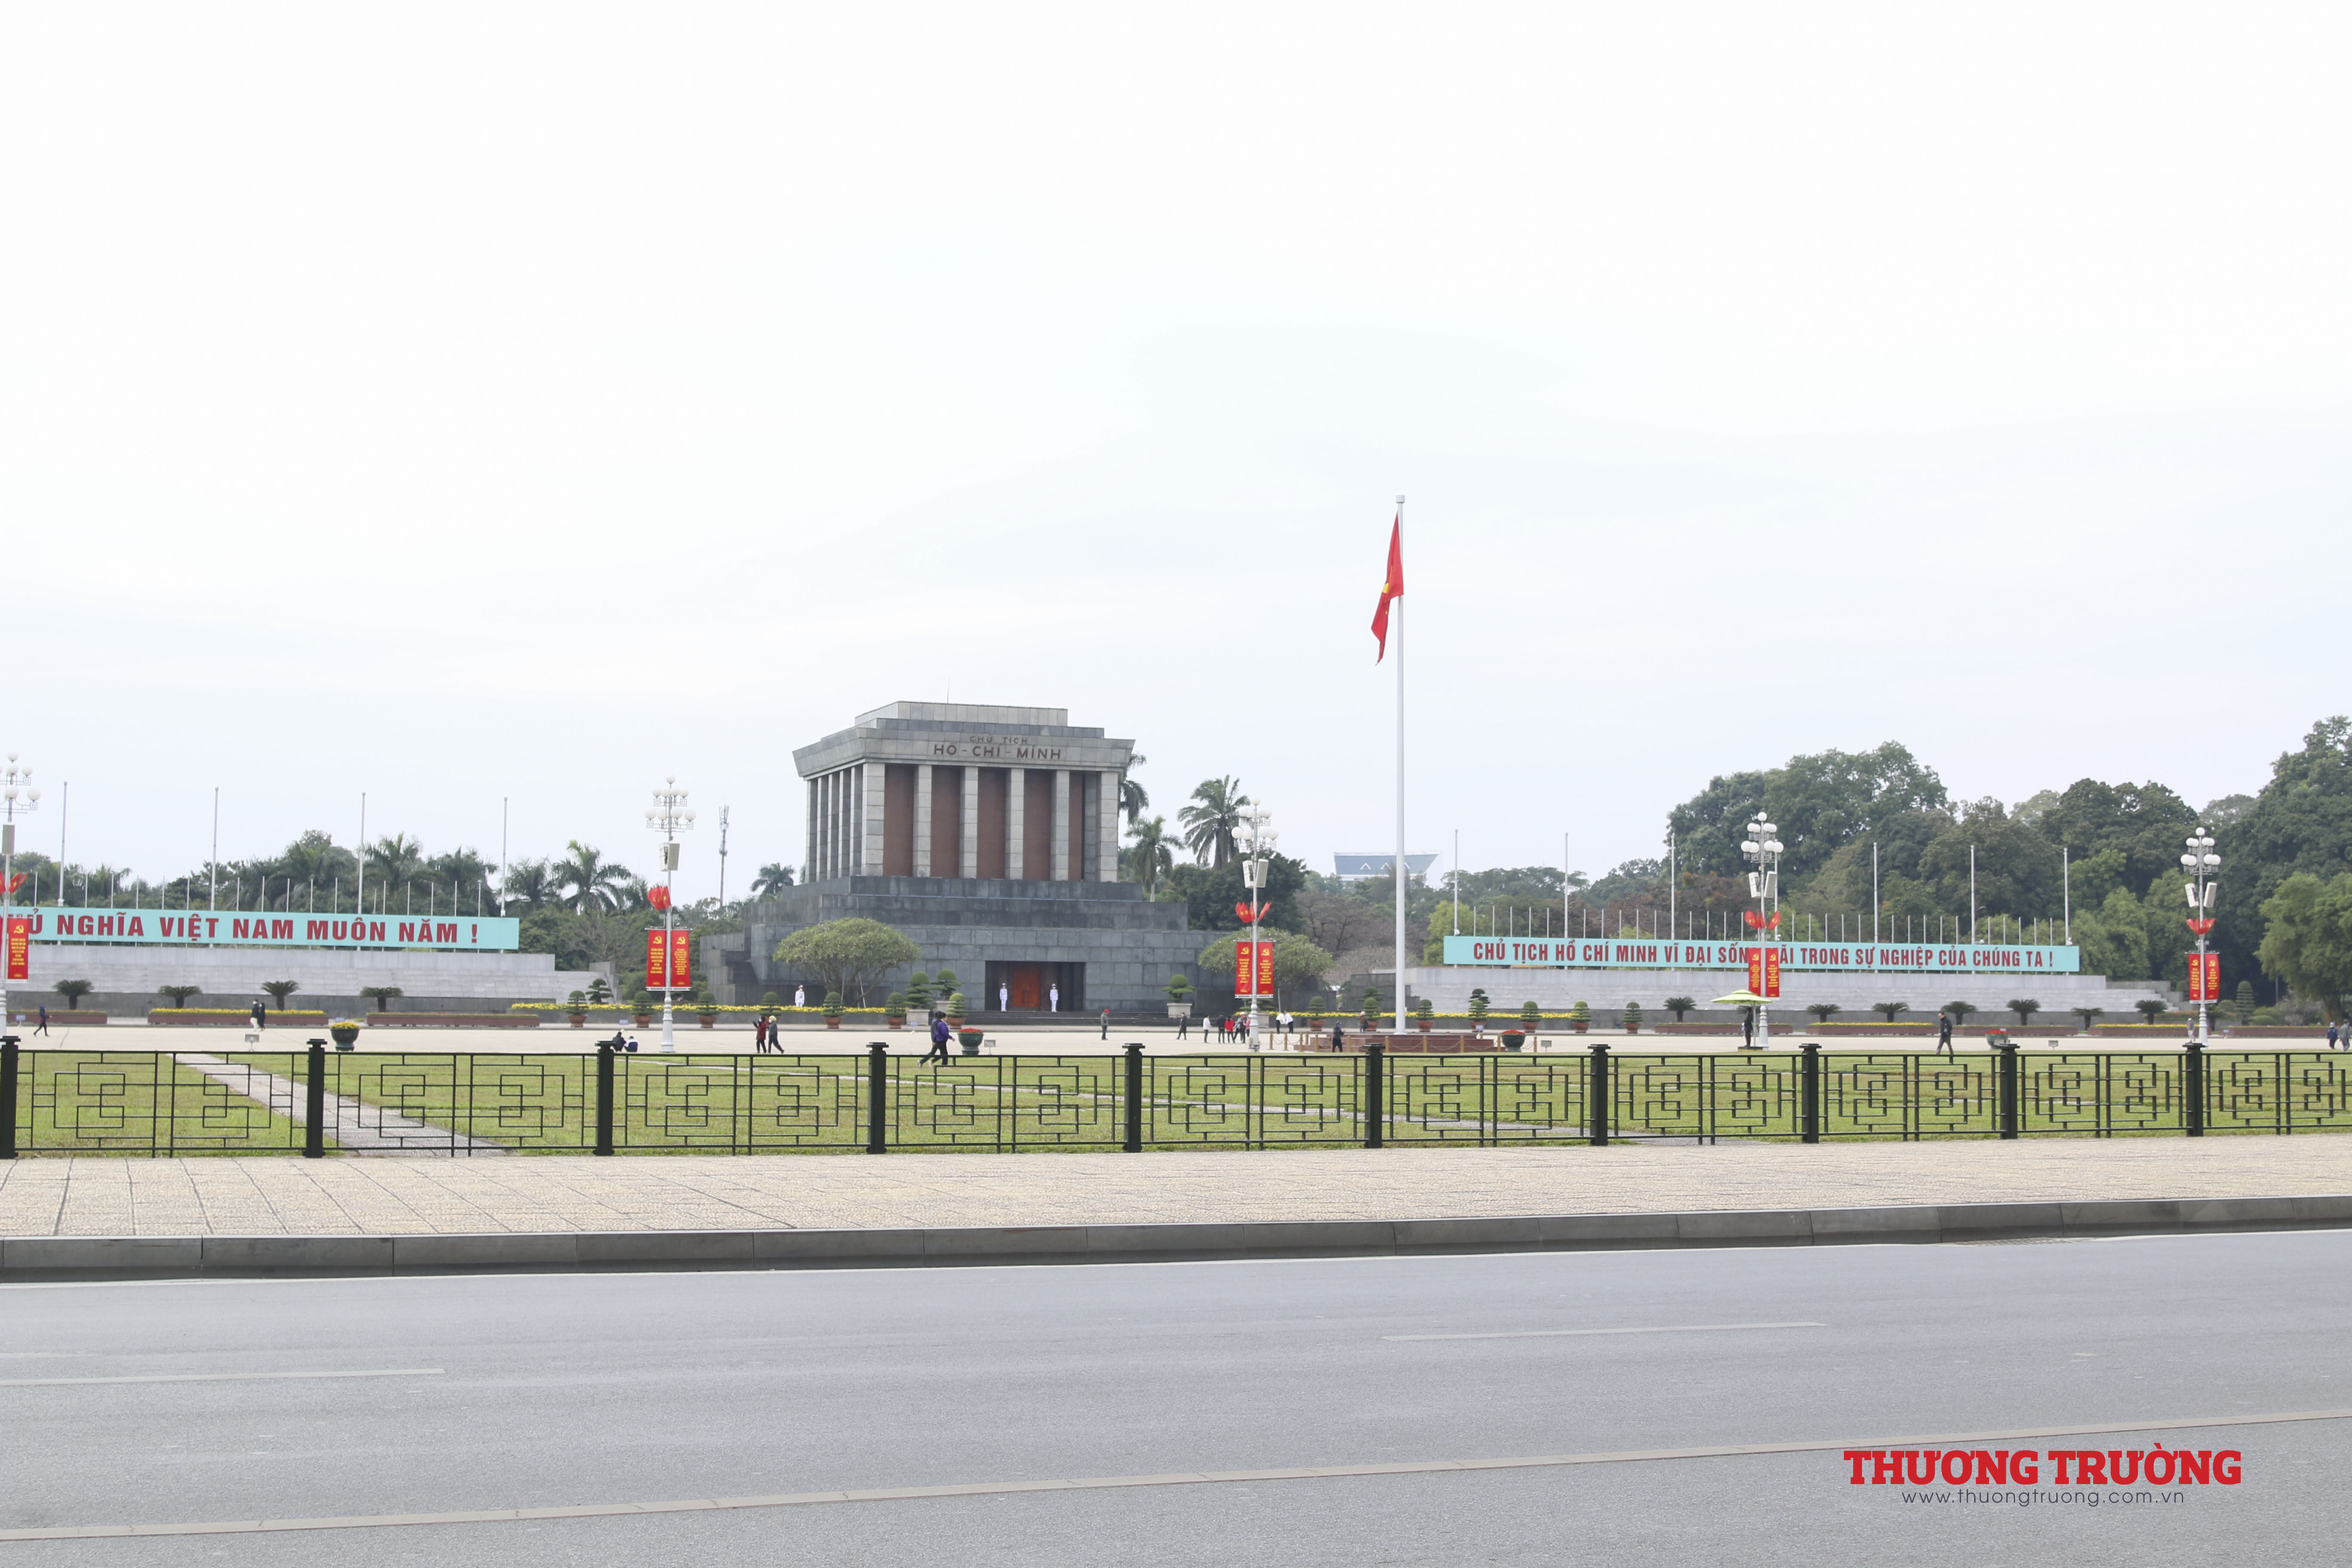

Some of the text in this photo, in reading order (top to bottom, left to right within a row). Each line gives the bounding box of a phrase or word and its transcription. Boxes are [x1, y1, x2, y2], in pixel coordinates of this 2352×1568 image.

[1016, 745, 1061, 760] MINH
[57, 912, 144, 937] NGHĨA
[159, 913, 219, 941] VIỆT
[233, 918, 294, 939] NAM
[307, 917, 386, 941] MUÔN
[399, 918, 457, 943] NĂM
[1473, 938, 1506, 960] CHỦ
[1512, 943, 1548, 964] TỊCH
[1555, 939, 1576, 962] HỒ
[1583, 941, 1609, 962] CHÍ
[1616, 945, 1657, 962] MINH
[1664, 943, 1678, 962] VĨ
[1685, 946, 1711, 966] ĐẠI
[1718, 942, 1749, 964] SỐN
[1779, 944, 1794, 964] ÃI
[1800, 947, 1849, 965] TRONG
[1855, 947, 1875, 968] SỰ
[1880, 946, 1933, 968] NGHIỆP
[1939, 945, 1967, 966] CỦA
[1973, 947, 2021, 967] CHÚNG
[2026, 951, 2043, 967] TA
